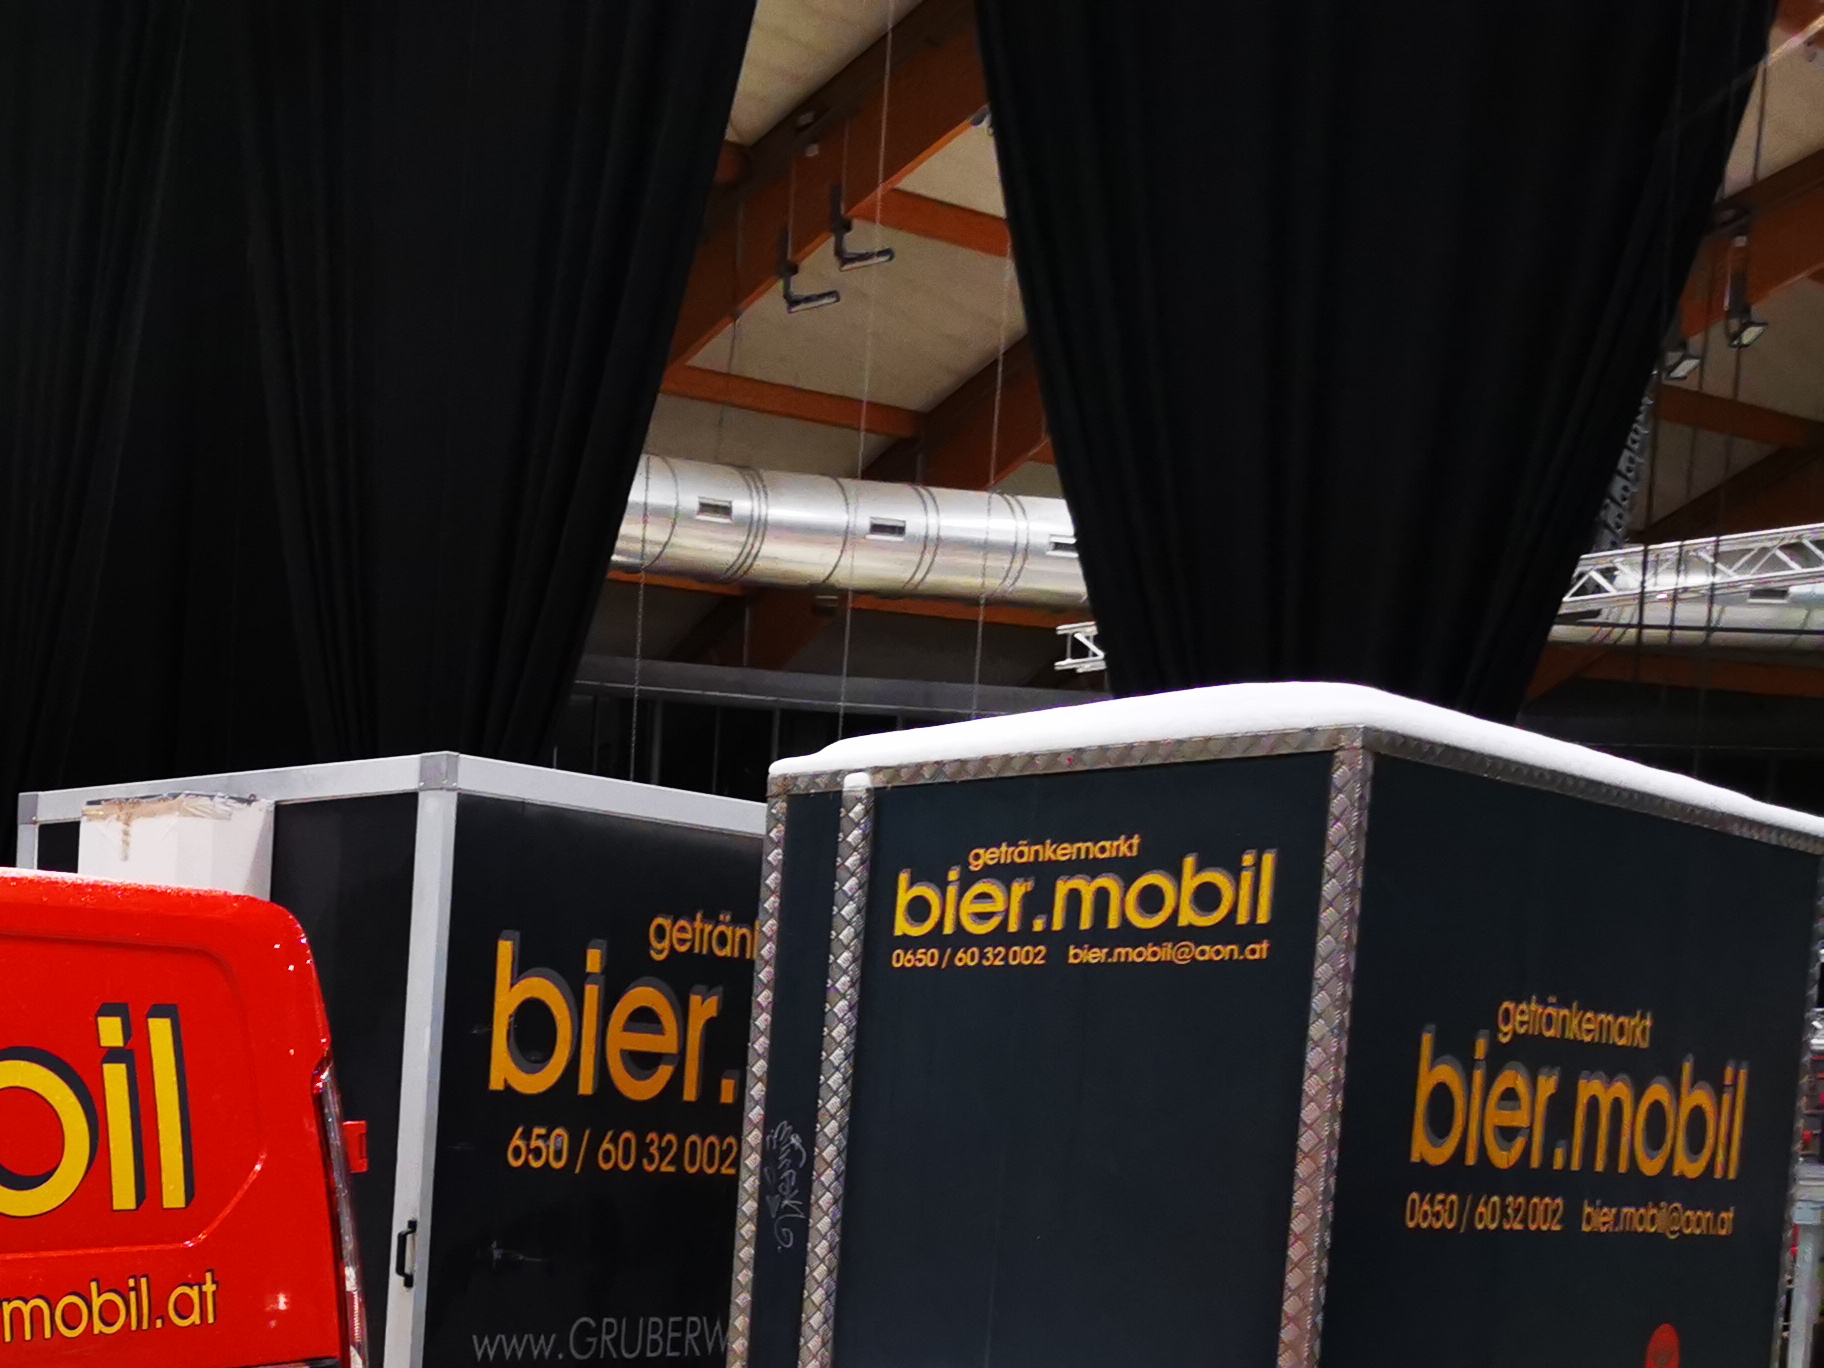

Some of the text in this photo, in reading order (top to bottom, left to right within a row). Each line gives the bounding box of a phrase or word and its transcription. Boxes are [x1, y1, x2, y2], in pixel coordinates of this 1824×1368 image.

[968, 834, 1141, 871] getränkemarkt
[893, 848, 1277, 937] bier.mobil
[891, 939, 1270, 969] 0650 / 60 32 002 bier.mobil@aon.at
[488, 929, 739, 1105] bier.
[1497, 995, 1654, 1048] getränkemarkt
[1410, 1023, 1749, 1180] bier.mobil
[507, 1124, 739, 1175] 650 / 60 32 002
[1405, 1192, 1458, 1229] 0650
[1459, 1194, 1473, 1233] /
[1475, 1195, 1500, 1230] 60
[1502, 1196, 1526, 1231] 32
[1528, 1196, 1563, 1231] 002
